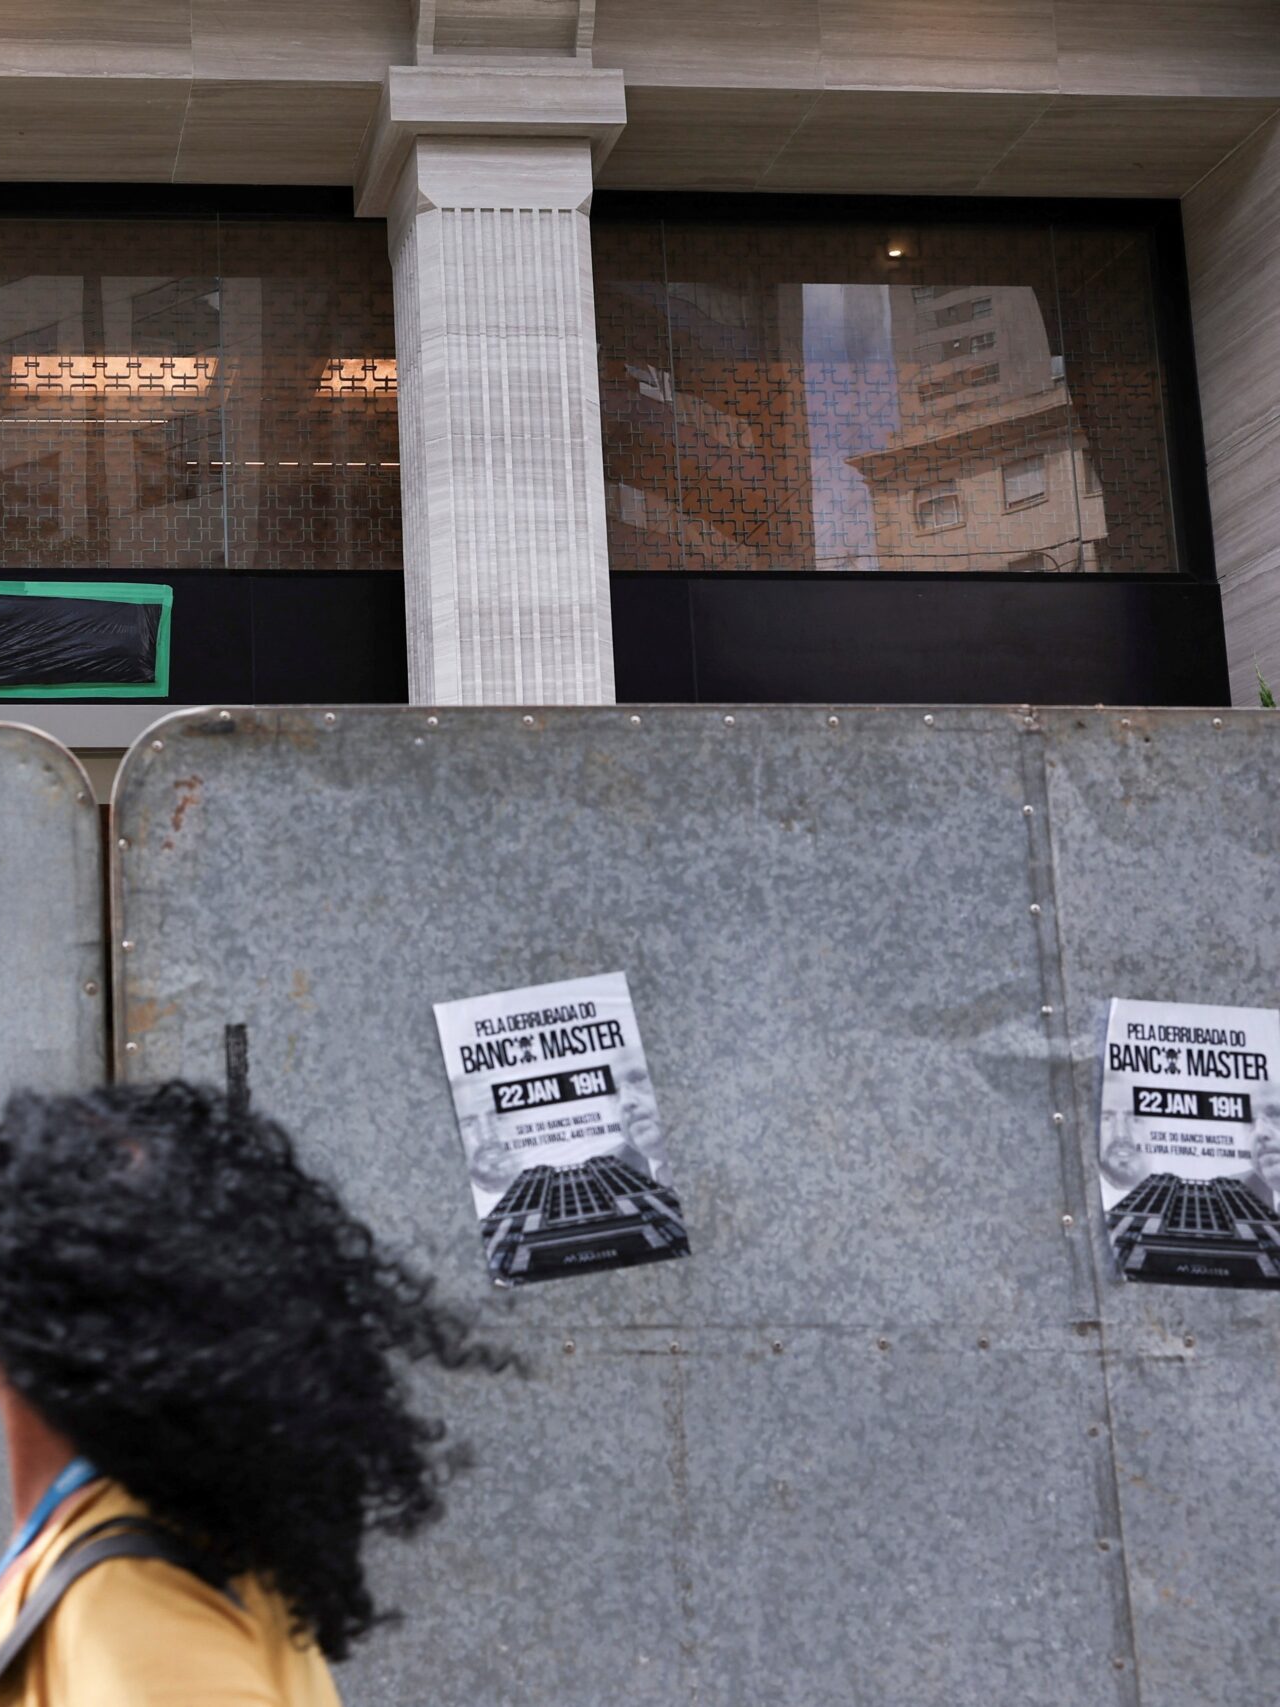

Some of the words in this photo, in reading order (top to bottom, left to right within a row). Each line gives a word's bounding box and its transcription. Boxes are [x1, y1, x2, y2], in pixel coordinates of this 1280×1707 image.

[475, 1017, 506, 1037] PELA
[507, 1005, 578, 1032] DERRUBADA
[578, 1002, 596, 1019] DO
[1127, 1023, 1156, 1040] PELA
[1158, 1025, 1228, 1046] DERRUBADA
[1230, 1030, 1246, 1047] DO
[538, 1019, 625, 1061] MASTER
[1186, 1048, 1269, 1081] MASTER
[498, 1085, 525, 1109] 22
[526, 1078, 561, 1104] JAN
[569, 1070, 607, 1096] 19H
[1138, 1091, 1163, 1113] 22
[1165, 1093, 1198, 1115] JAN
[1208, 1096, 1243, 1119] 19H
